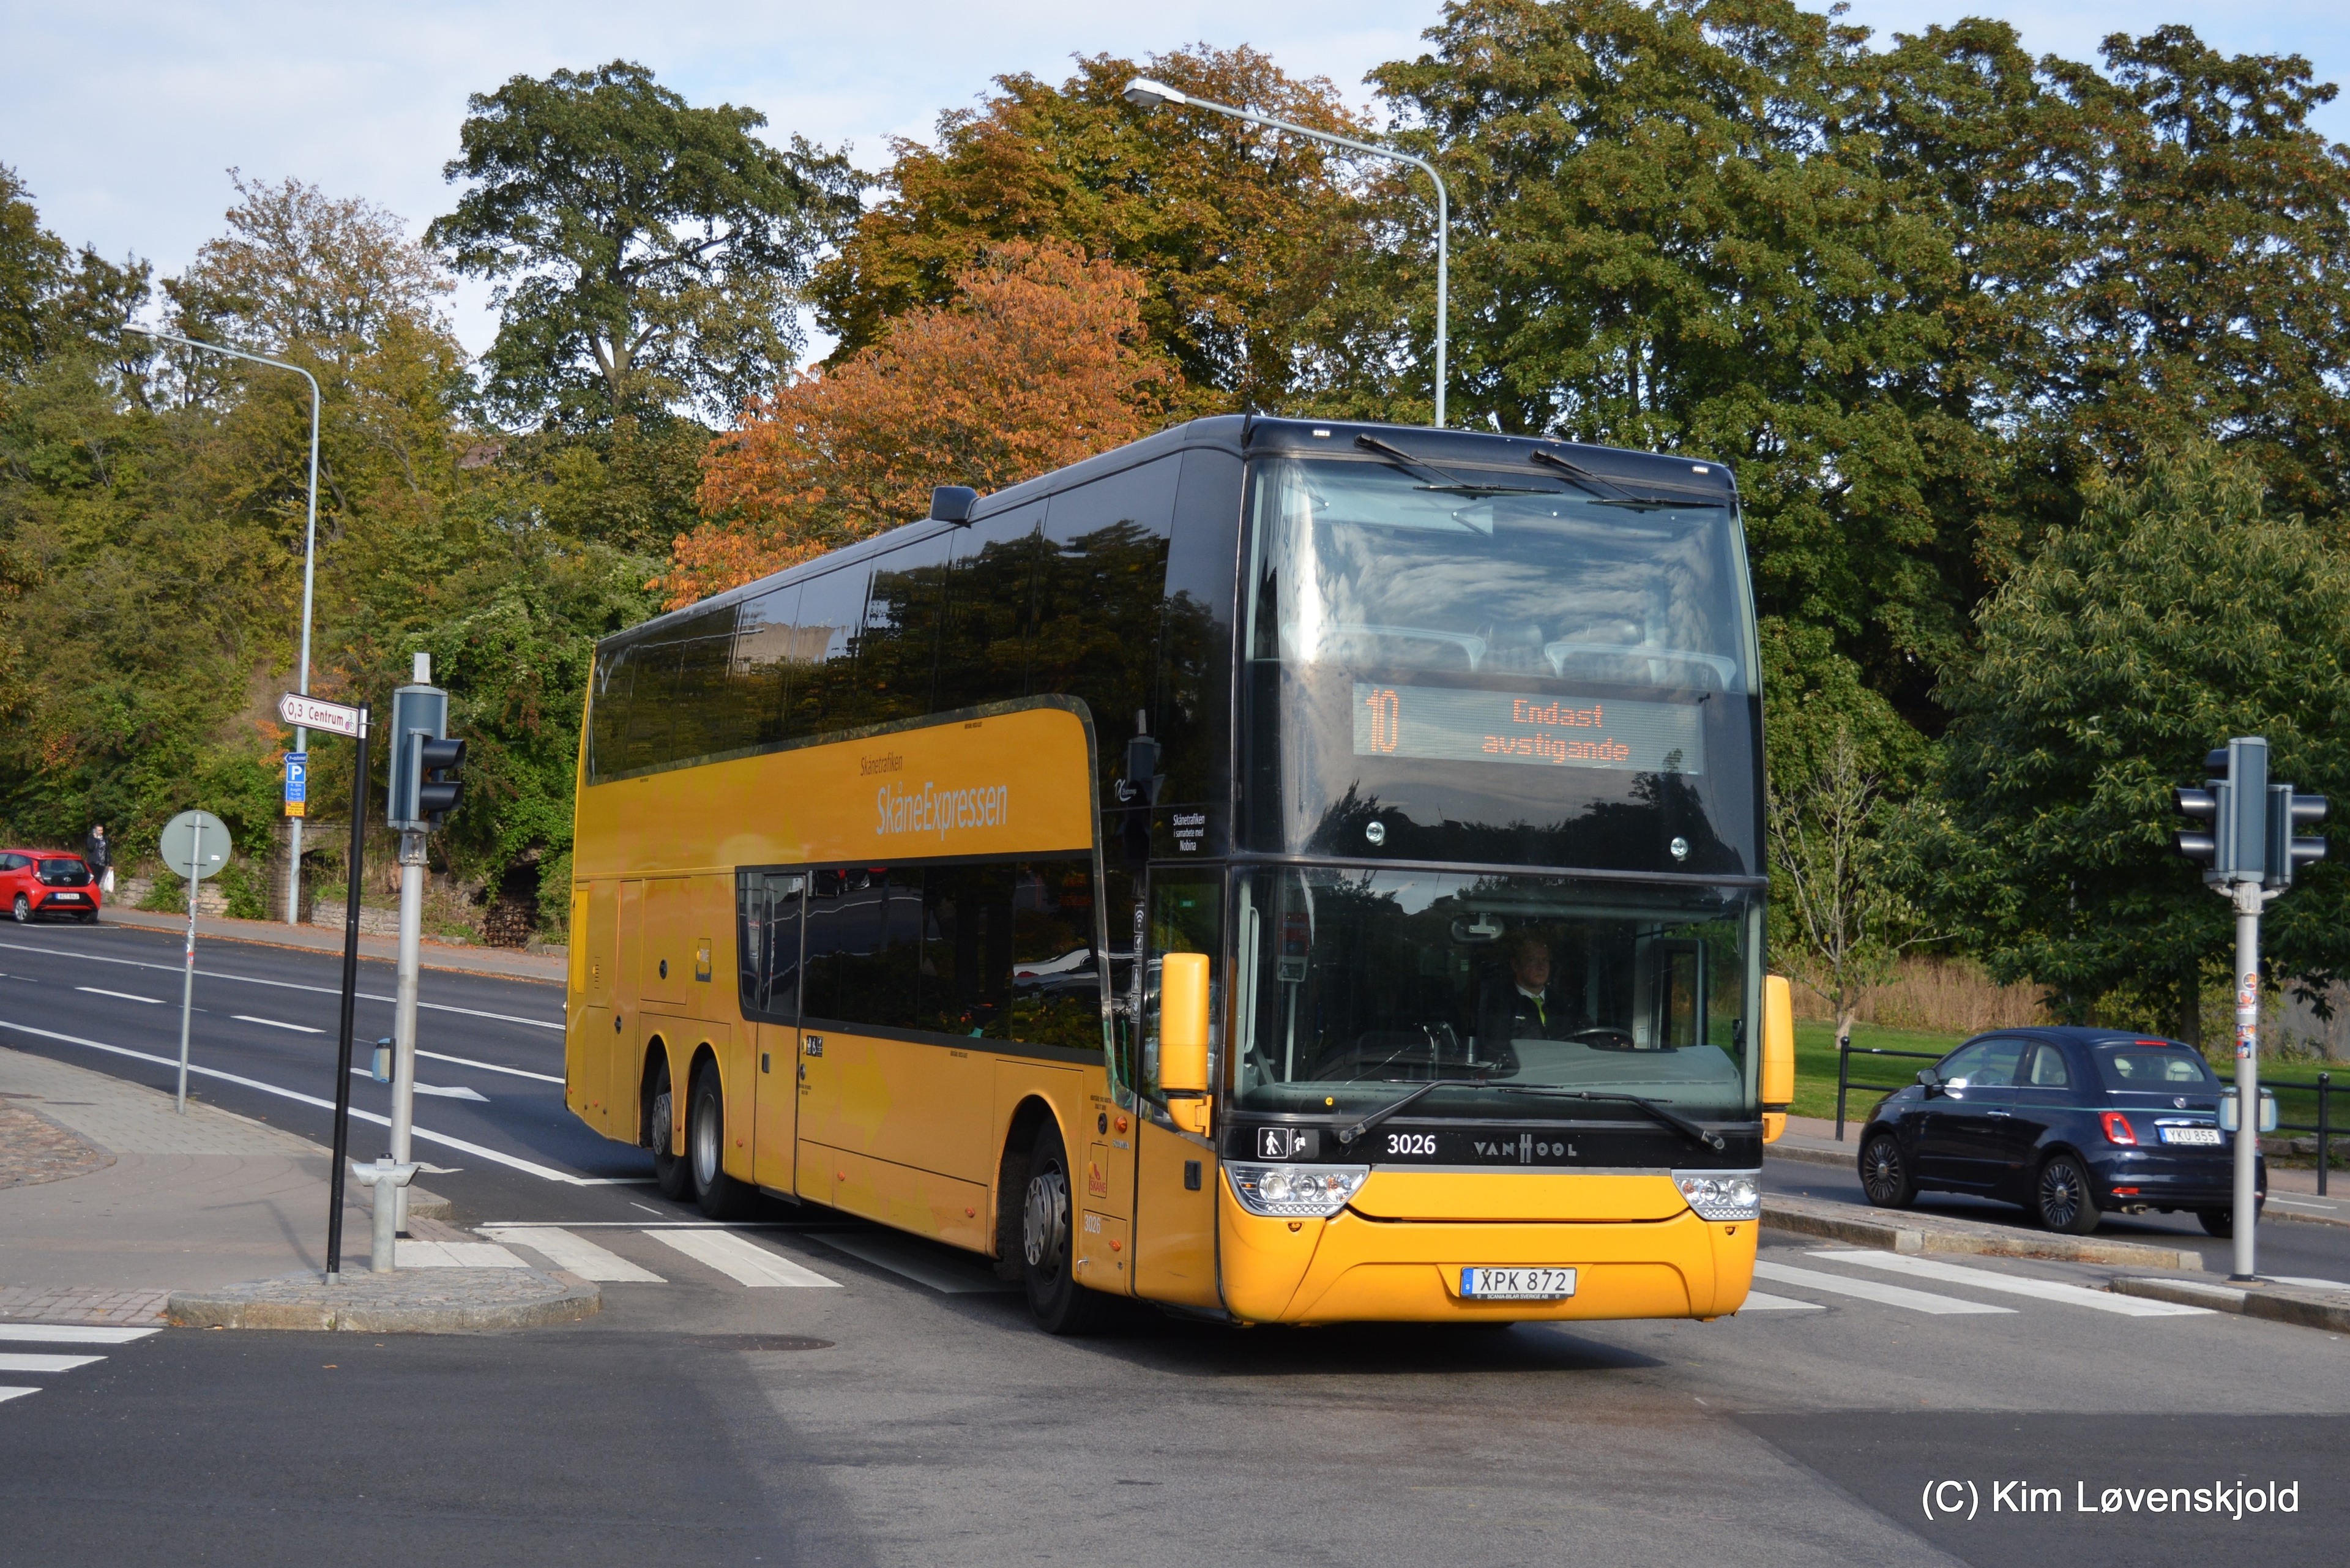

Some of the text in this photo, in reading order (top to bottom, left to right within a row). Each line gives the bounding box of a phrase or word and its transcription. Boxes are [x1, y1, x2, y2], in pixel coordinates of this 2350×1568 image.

[288, 701, 344, 726] 0,3 Centrum
[1366, 689, 1399, 753] 10
[1513, 699, 1603, 728] Endast
[1482, 734, 1629, 764] avstigande
[291, 765, 302, 780] P
[860, 752, 903, 777] Skånetrafiken
[876, 781, 1009, 842] SkåneExpressen
[1173, 813, 1205, 826] Skånetrafiken
[1176, 828, 1195, 837] samarbete
[1195, 827, 1204, 837] med
[1179, 839, 1196, 851] Nobina
[1387, 1134, 1436, 1154] 3026
[2169, 1130, 2215, 1142] YKU 855
[1084, 1214, 1101, 1234] 3026
[1480, 1271, 1520, 1291] XPK
[1527, 1272, 1566, 1291] 872
